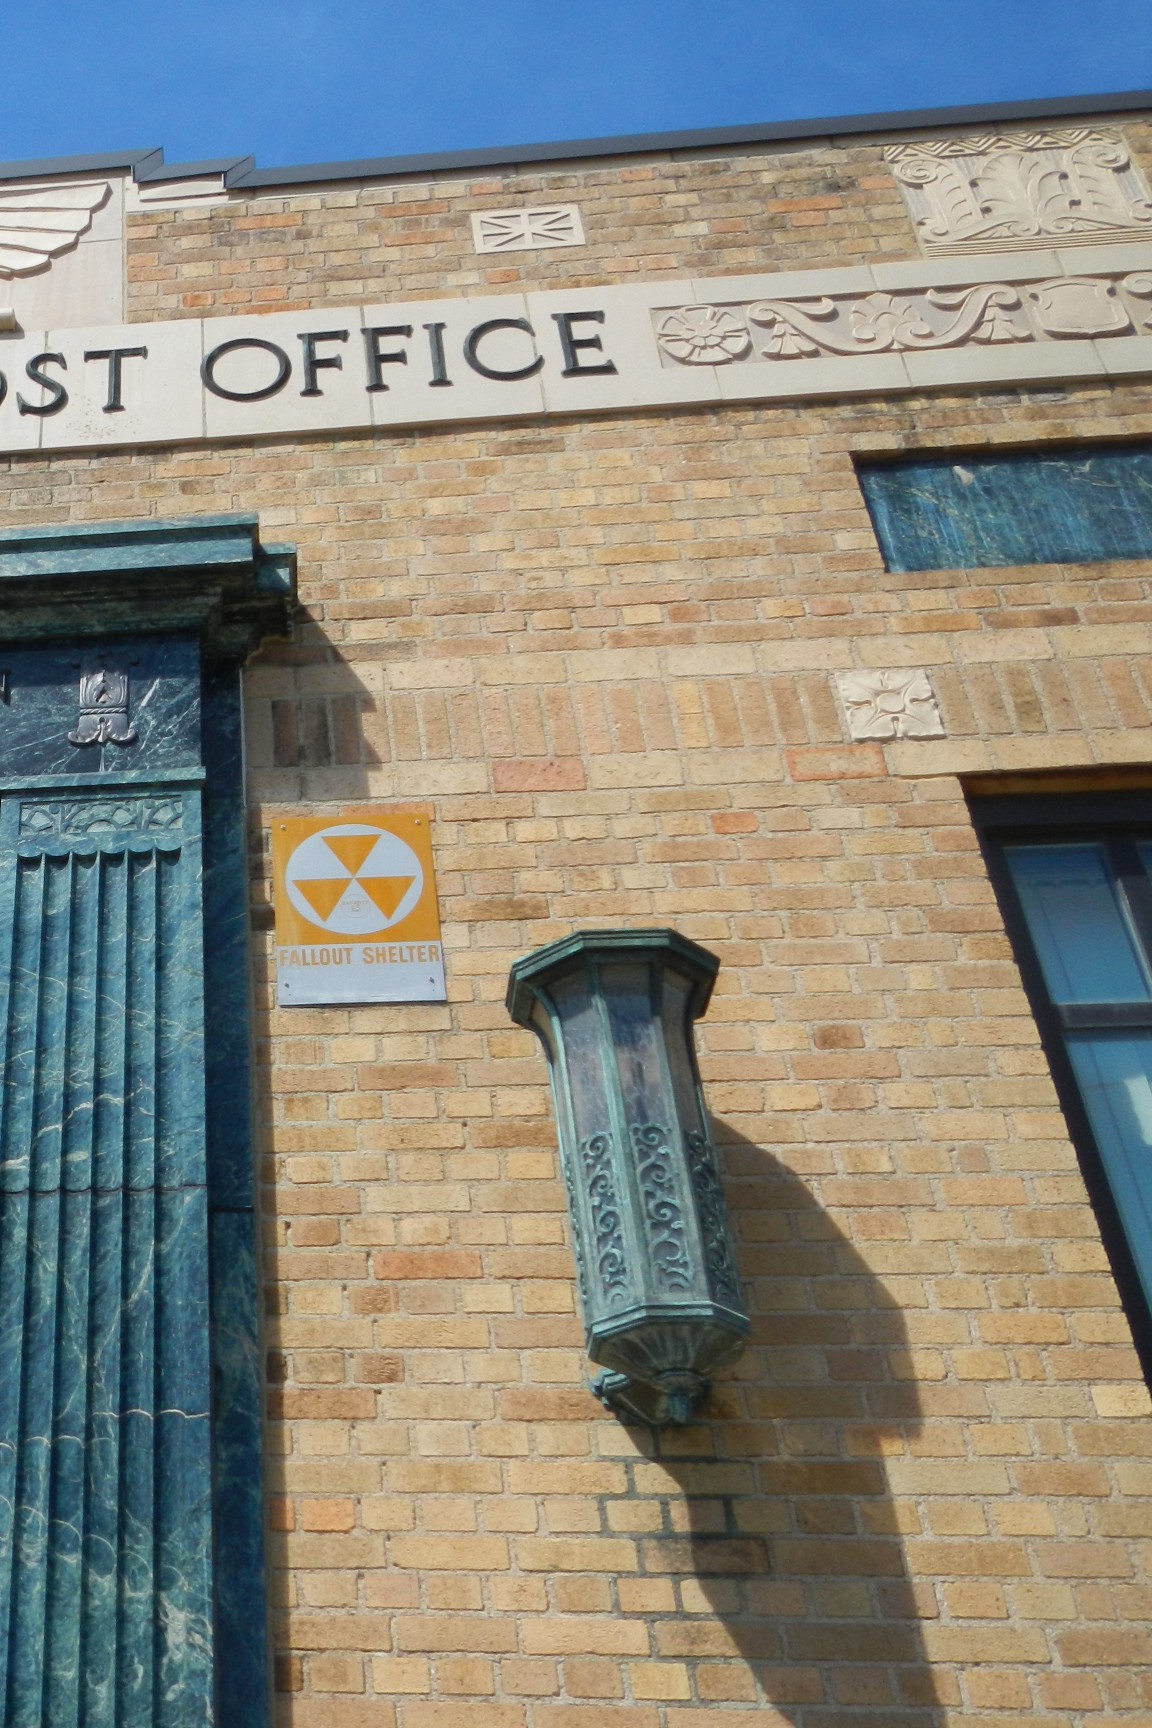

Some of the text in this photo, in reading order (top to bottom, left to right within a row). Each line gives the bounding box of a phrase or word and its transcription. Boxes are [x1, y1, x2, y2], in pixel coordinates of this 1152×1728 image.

[200, 310, 618, 402] OFFICE
[279, 944, 440, 967] FALLOUT SHELTER
